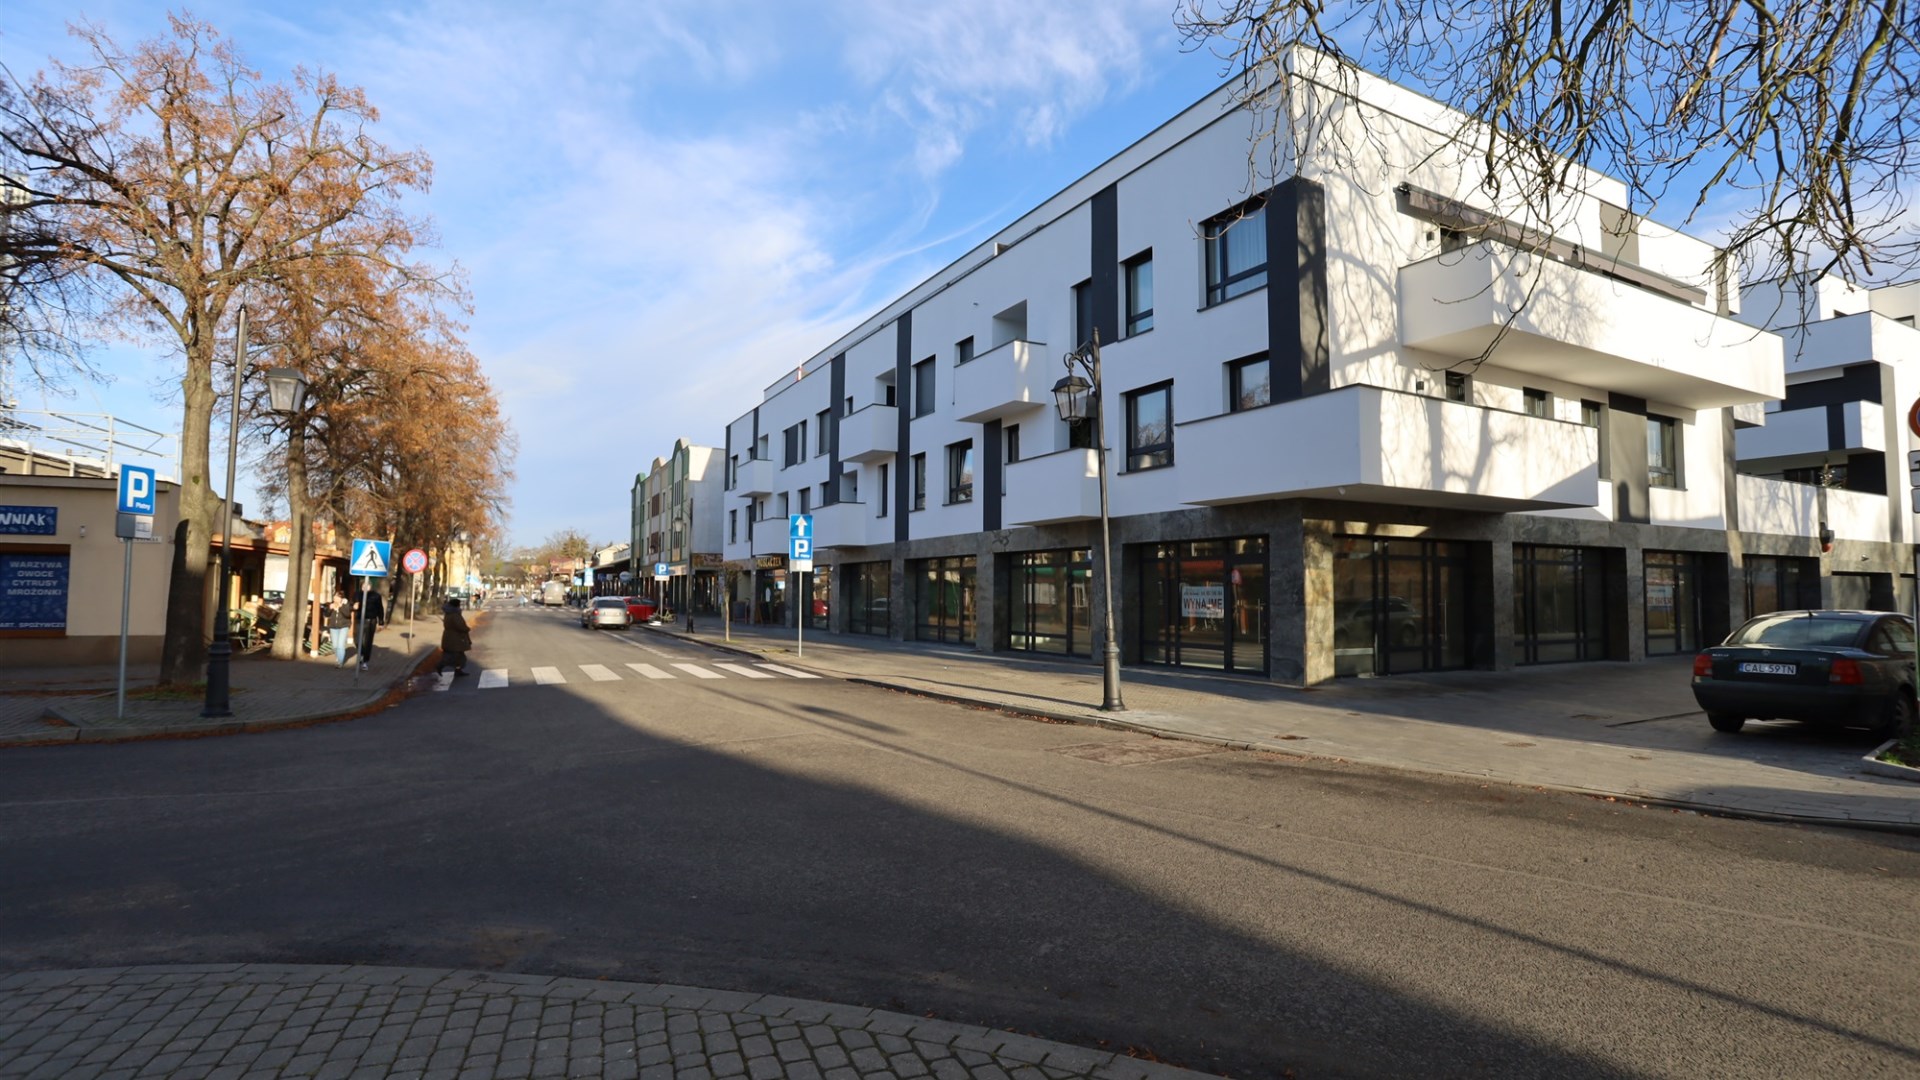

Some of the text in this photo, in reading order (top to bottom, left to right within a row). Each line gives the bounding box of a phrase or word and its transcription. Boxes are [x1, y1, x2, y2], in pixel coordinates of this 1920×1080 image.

[126, 469, 149, 508] P
[794, 539, 809, 558] P
[9, 561, 63, 569] WARZYWA
[17, 570, 55, 578] OWOCE
[12, 579, 58, 587] CYTRUSY
[1744, 663, 1765, 673] CAL
[1769, 664, 1795, 675] 59TN
